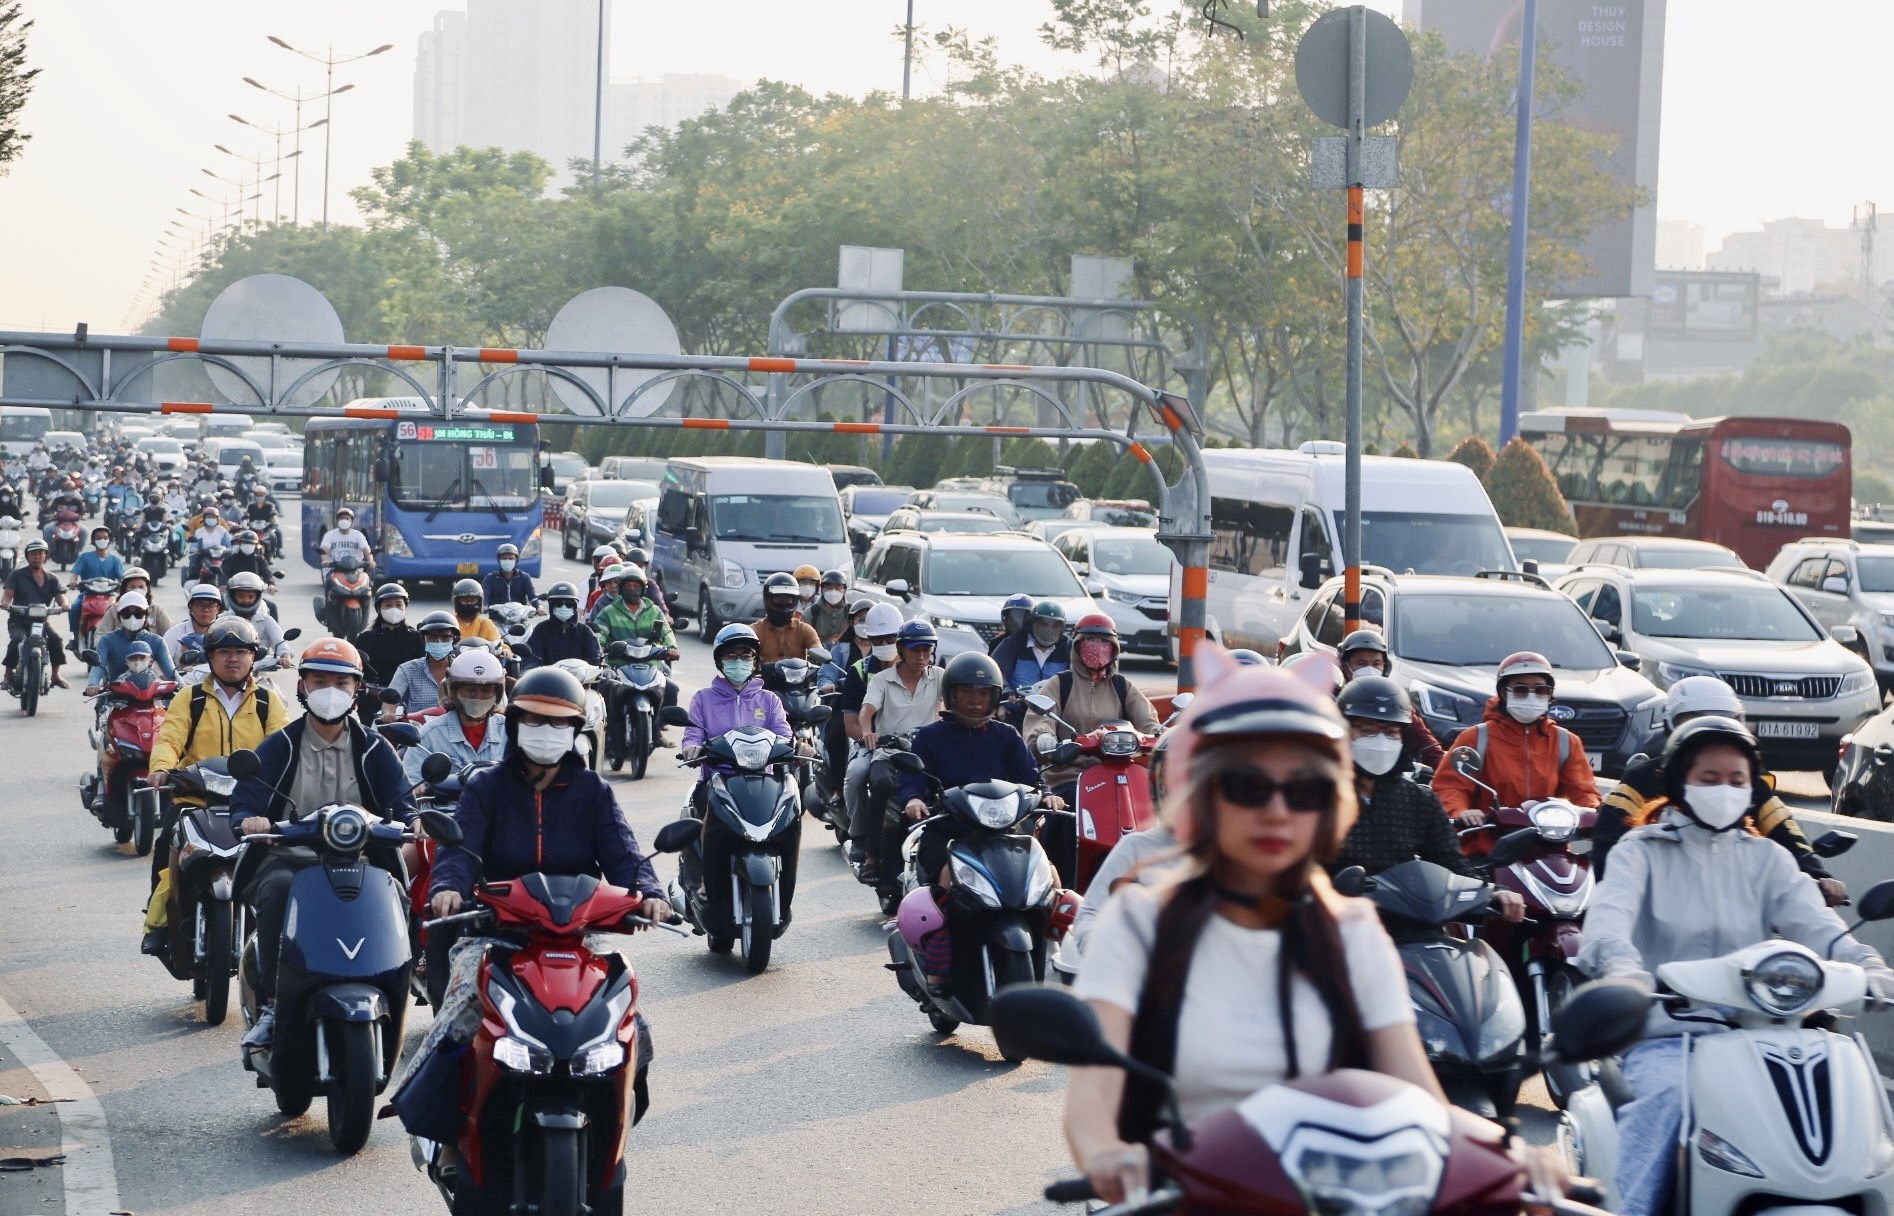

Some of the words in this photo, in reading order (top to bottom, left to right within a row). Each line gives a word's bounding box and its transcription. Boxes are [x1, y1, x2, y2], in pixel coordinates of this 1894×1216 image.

[1591, 6, 1626, 17] THUY
[1578, 20, 1625, 32] DESIGN
[1580, 36, 1625, 47] HOUSE
[400, 424, 414, 437] 56
[1779, 684, 1794, 692] KIA
[545, 952, 577, 960] HONDA
